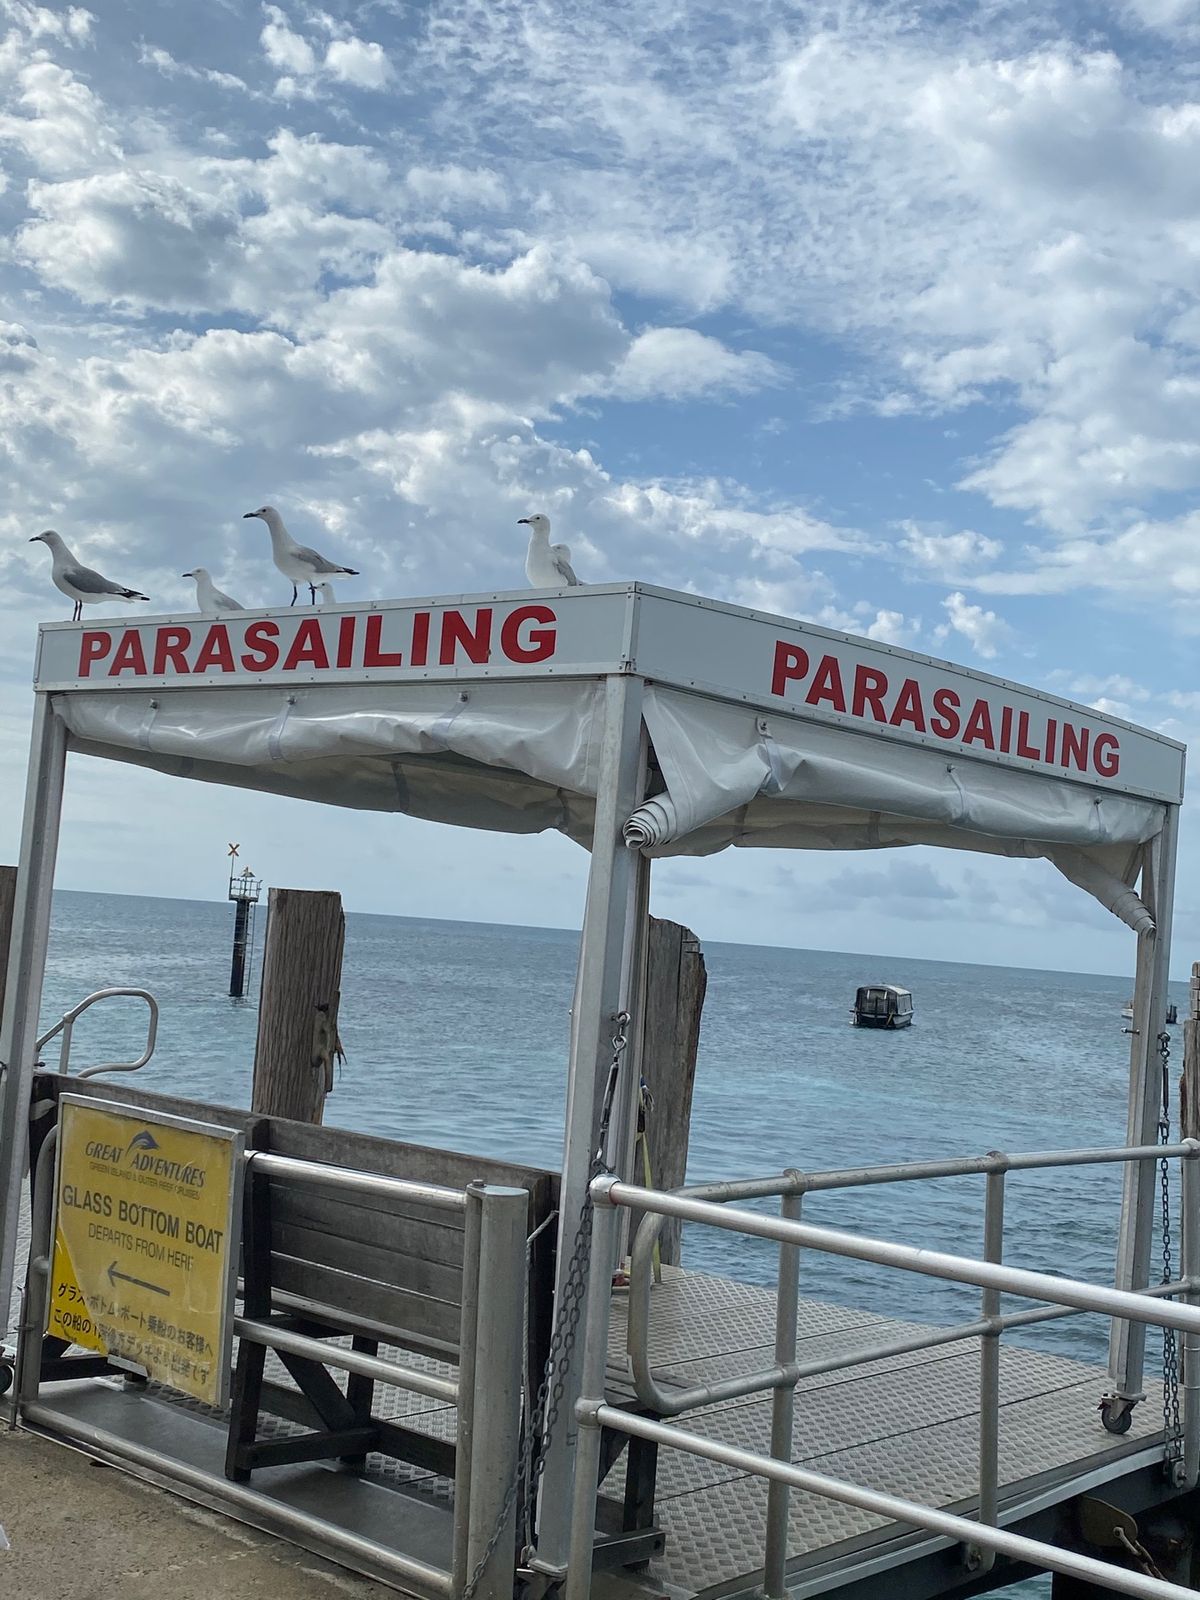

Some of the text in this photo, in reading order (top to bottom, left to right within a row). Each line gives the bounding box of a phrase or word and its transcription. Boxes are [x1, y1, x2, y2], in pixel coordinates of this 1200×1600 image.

[77, 605, 557, 678] PARASAILING
[771, 639, 1120, 778] PARASAILING
[85, 1141, 206, 1189] GREAT ADVENTURES
[89, 1161, 110, 1176] GREEN
[110, 1166, 132, 1181] ISLAND
[138, 1174, 158, 1187] OUTER
[62, 1185, 223, 1254] GLASS BOTTOM BOAT
[88, 1223, 133, 1250] DEPARTS
[135, 1238, 165, 1262] FROM
